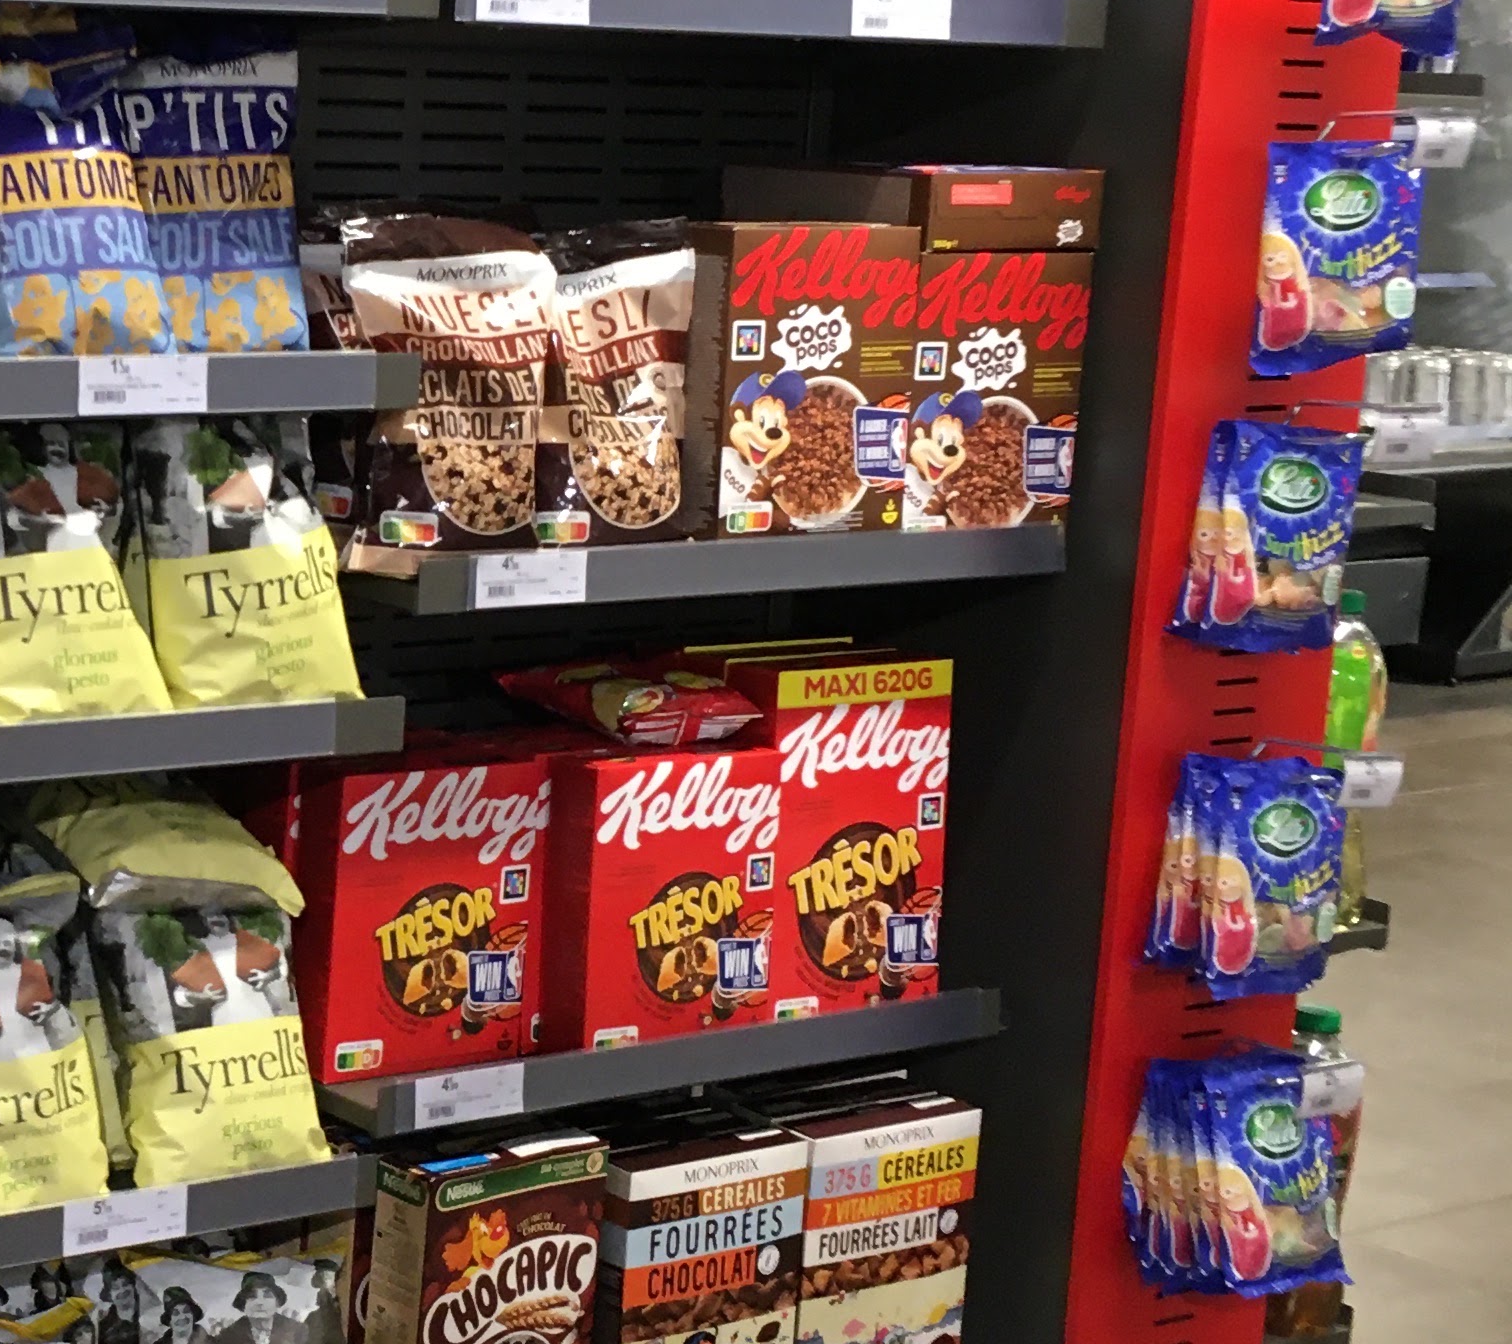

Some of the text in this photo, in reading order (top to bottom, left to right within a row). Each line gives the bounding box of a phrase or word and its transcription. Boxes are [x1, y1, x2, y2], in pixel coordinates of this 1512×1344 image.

[125, 88, 288, 153] P'TITS
[95, 214, 157, 270] SAL
[416, 262, 508, 283] MONOPRIX
[558, 271, 617, 297] OPRIX
[558, 289, 650, 348] ESLI
[795, 338, 838, 366] pops
[419, 367, 535, 405] CLATS DE
[974, 359, 1013, 386] pops
[415, 409, 524, 441] CHOCOLAT
[53, 646, 119, 672] glorious
[266, 657, 306, 681] pesto
[66, 671, 111, 694] pesto
[803, 667, 933, 700] MAXI 620G
[160, 1028, 308, 1115] Tyrrell's
[221, 1114, 284, 1139] glorious
[864, 1125, 935, 1151] MONOPRIX
[232, 1137, 274, 1161] pesto
[883, 1144, 965, 1184] CÉRÉALES
[684, 1157, 759, 1184] MONOPRIX
[702, 1175, 786, 1214] CÉRÉALES
[836, 1188, 913, 1223] VITAMINES
[917, 1184, 935, 1208] ET
[521, 1223, 567, 1237] CHOCOLAT
[649, 1205, 783, 1262] FOURRÉES
[818, 1212, 937, 1260] FOURRÉES LAIT
[647, 1249, 755, 1300] CHOCOLAT
